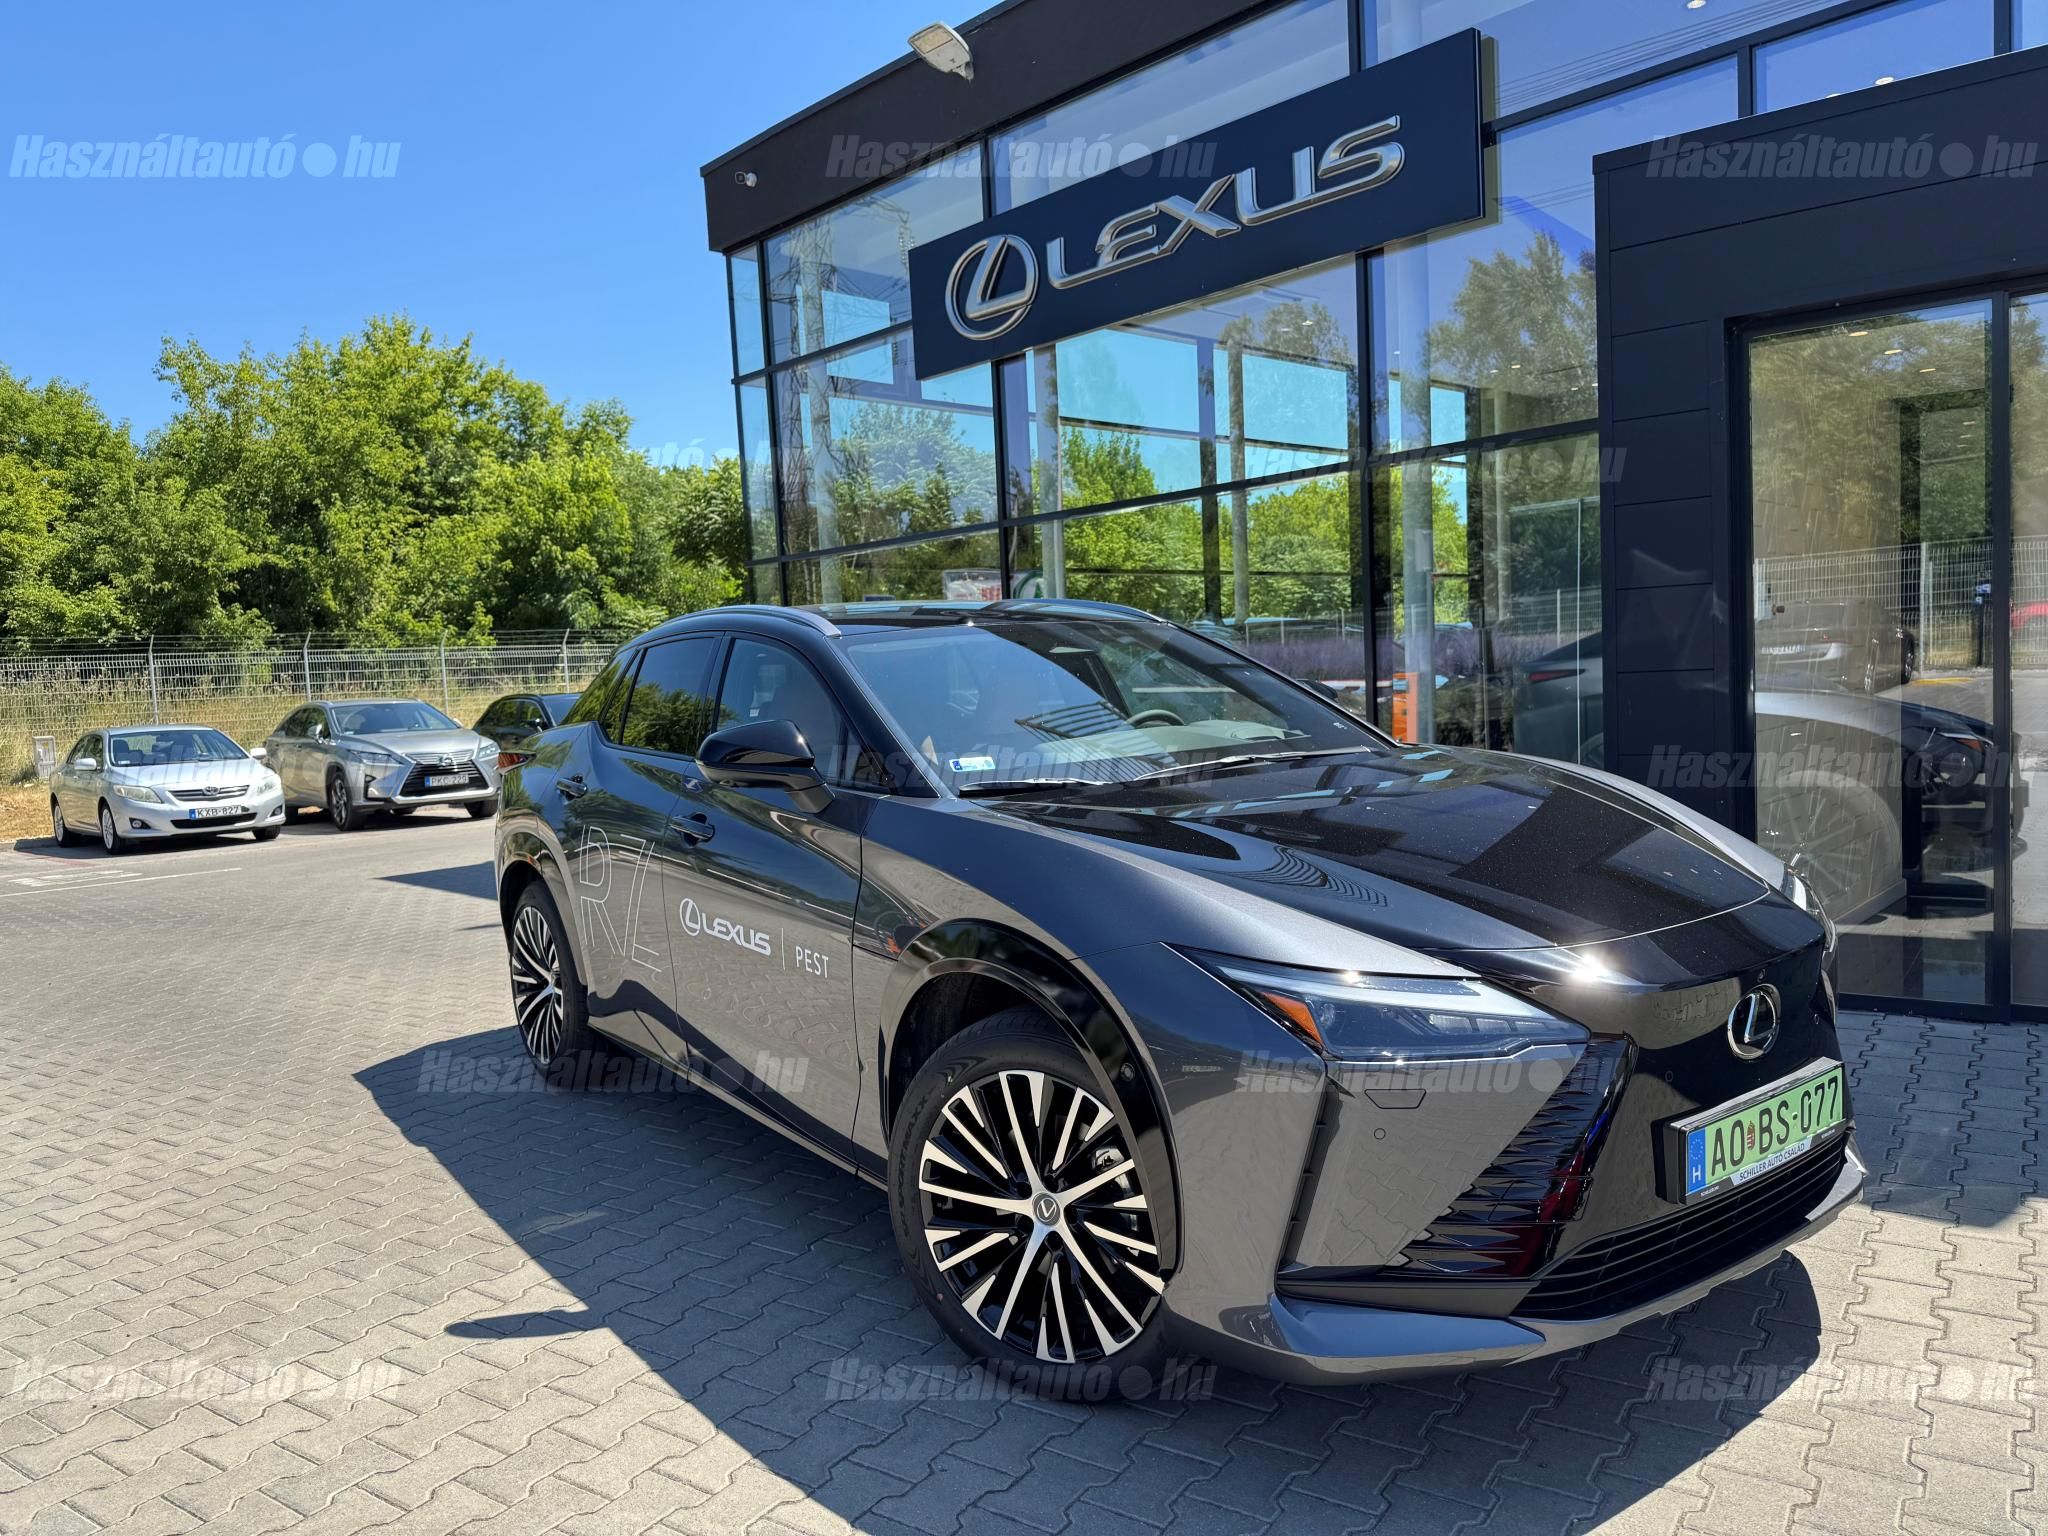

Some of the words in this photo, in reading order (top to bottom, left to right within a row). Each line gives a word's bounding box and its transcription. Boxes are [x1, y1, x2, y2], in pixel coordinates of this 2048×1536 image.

[1046, 114, 1405, 289] LEXUS
[702, 913, 771, 956] LEXUS
[795, 945, 829, 978] PEST
[1692, 1164, 1701, 1184] H
[1739, 1161, 1767, 1181] SCHILLER
[1783, 1142, 1806, 1161] CSALÁD
